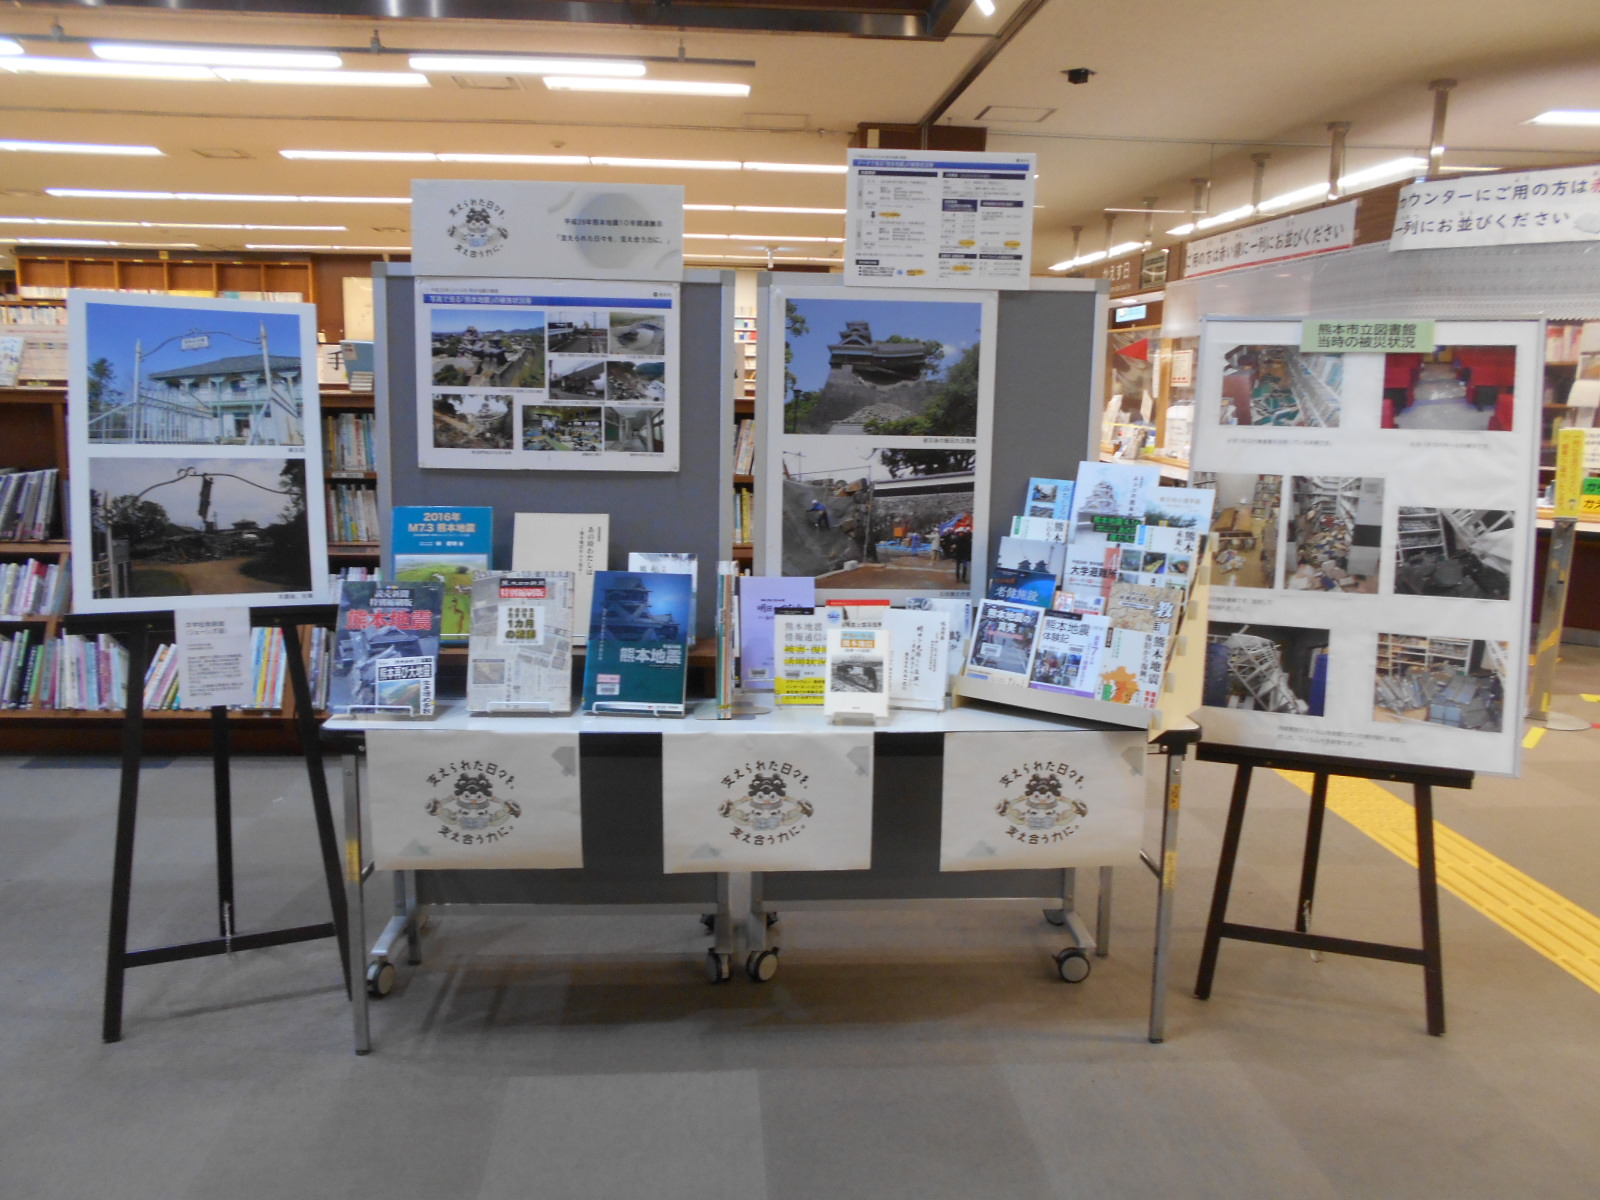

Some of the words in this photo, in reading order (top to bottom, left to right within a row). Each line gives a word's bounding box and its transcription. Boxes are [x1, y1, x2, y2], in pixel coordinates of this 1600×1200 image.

[1394, 211, 1572, 237] 一列にお並びください
[1318, 323, 1417, 336] 熊本市立図書館
[1318, 336, 1416, 348] 当時の被災状況
[423, 512, 461, 521] 2016年
[437, 523, 476, 533] 熊本地震
[1184, 531, 1196, 552] 熊本
[995, 586, 1039, 602] 老健施設
[346, 608, 433, 631] 熊本地震
[987, 608, 1032, 623] 熊本地震の
[1045, 620, 1091, 636] 熊本地震
[1043, 632, 1070, 643] 体験記
[620, 647, 682, 665] 熊本地震
[1148, 636, 1166, 686] 熊本地震
